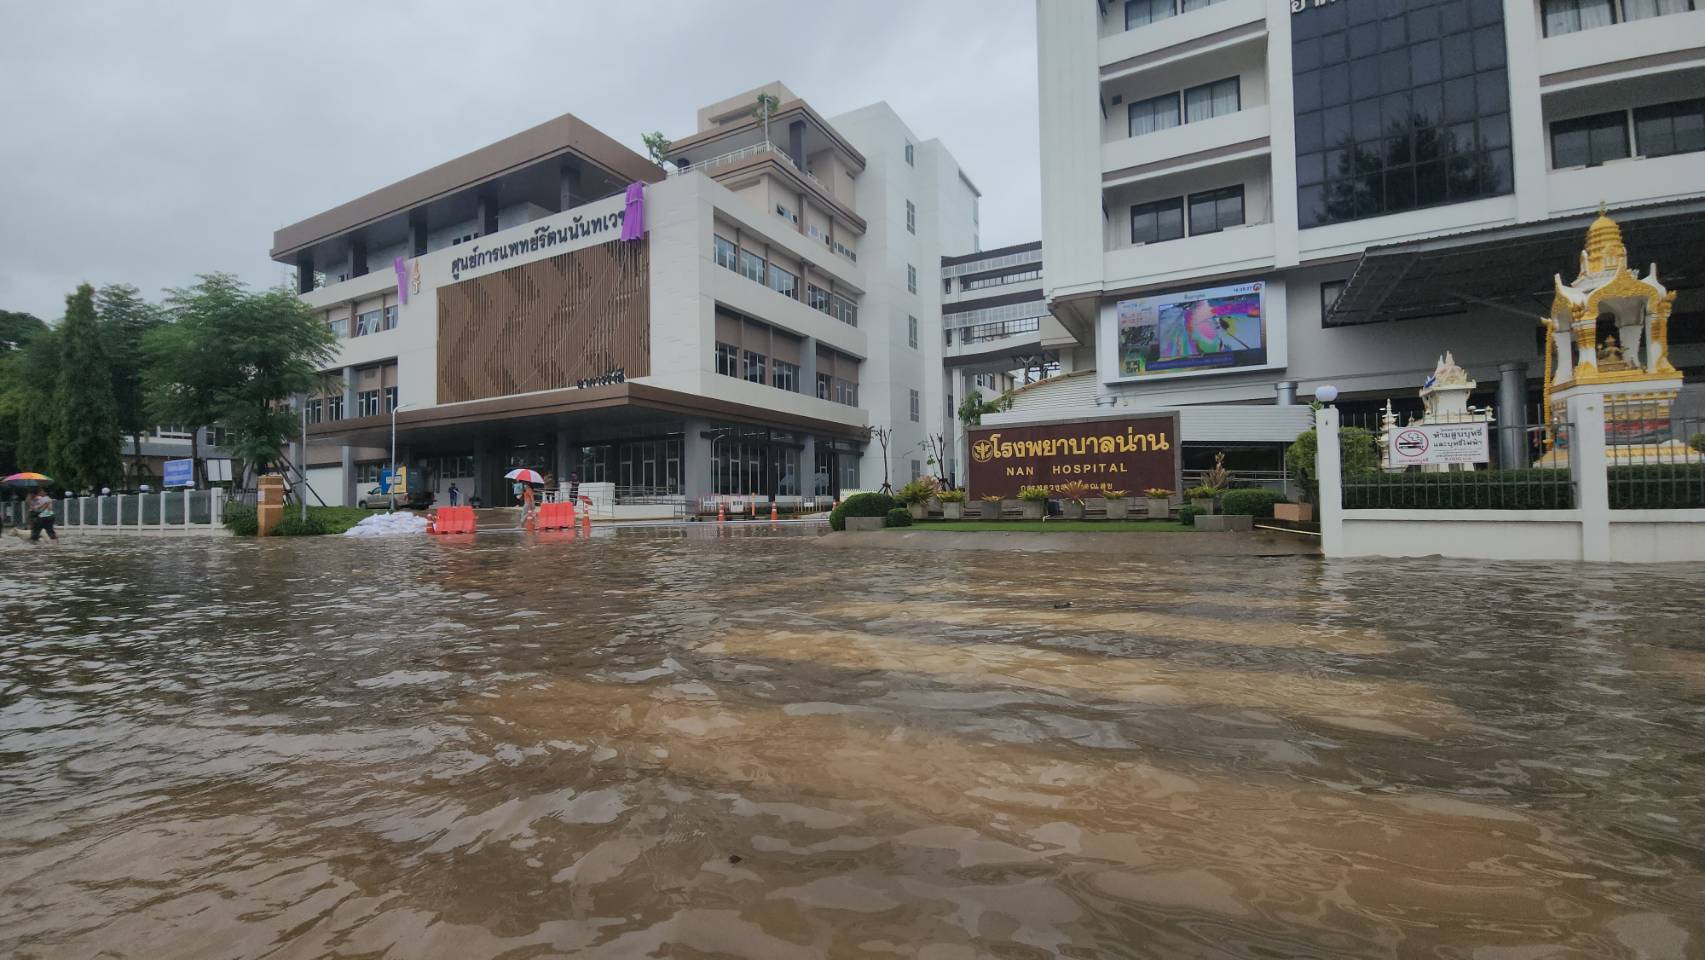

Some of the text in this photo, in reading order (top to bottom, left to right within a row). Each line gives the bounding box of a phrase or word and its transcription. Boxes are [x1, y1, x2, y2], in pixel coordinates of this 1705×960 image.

[989, 426, 1170, 459] โรงพยาบาลน่าน
[1006, 463, 1129, 477] NAN HOSPITAL
